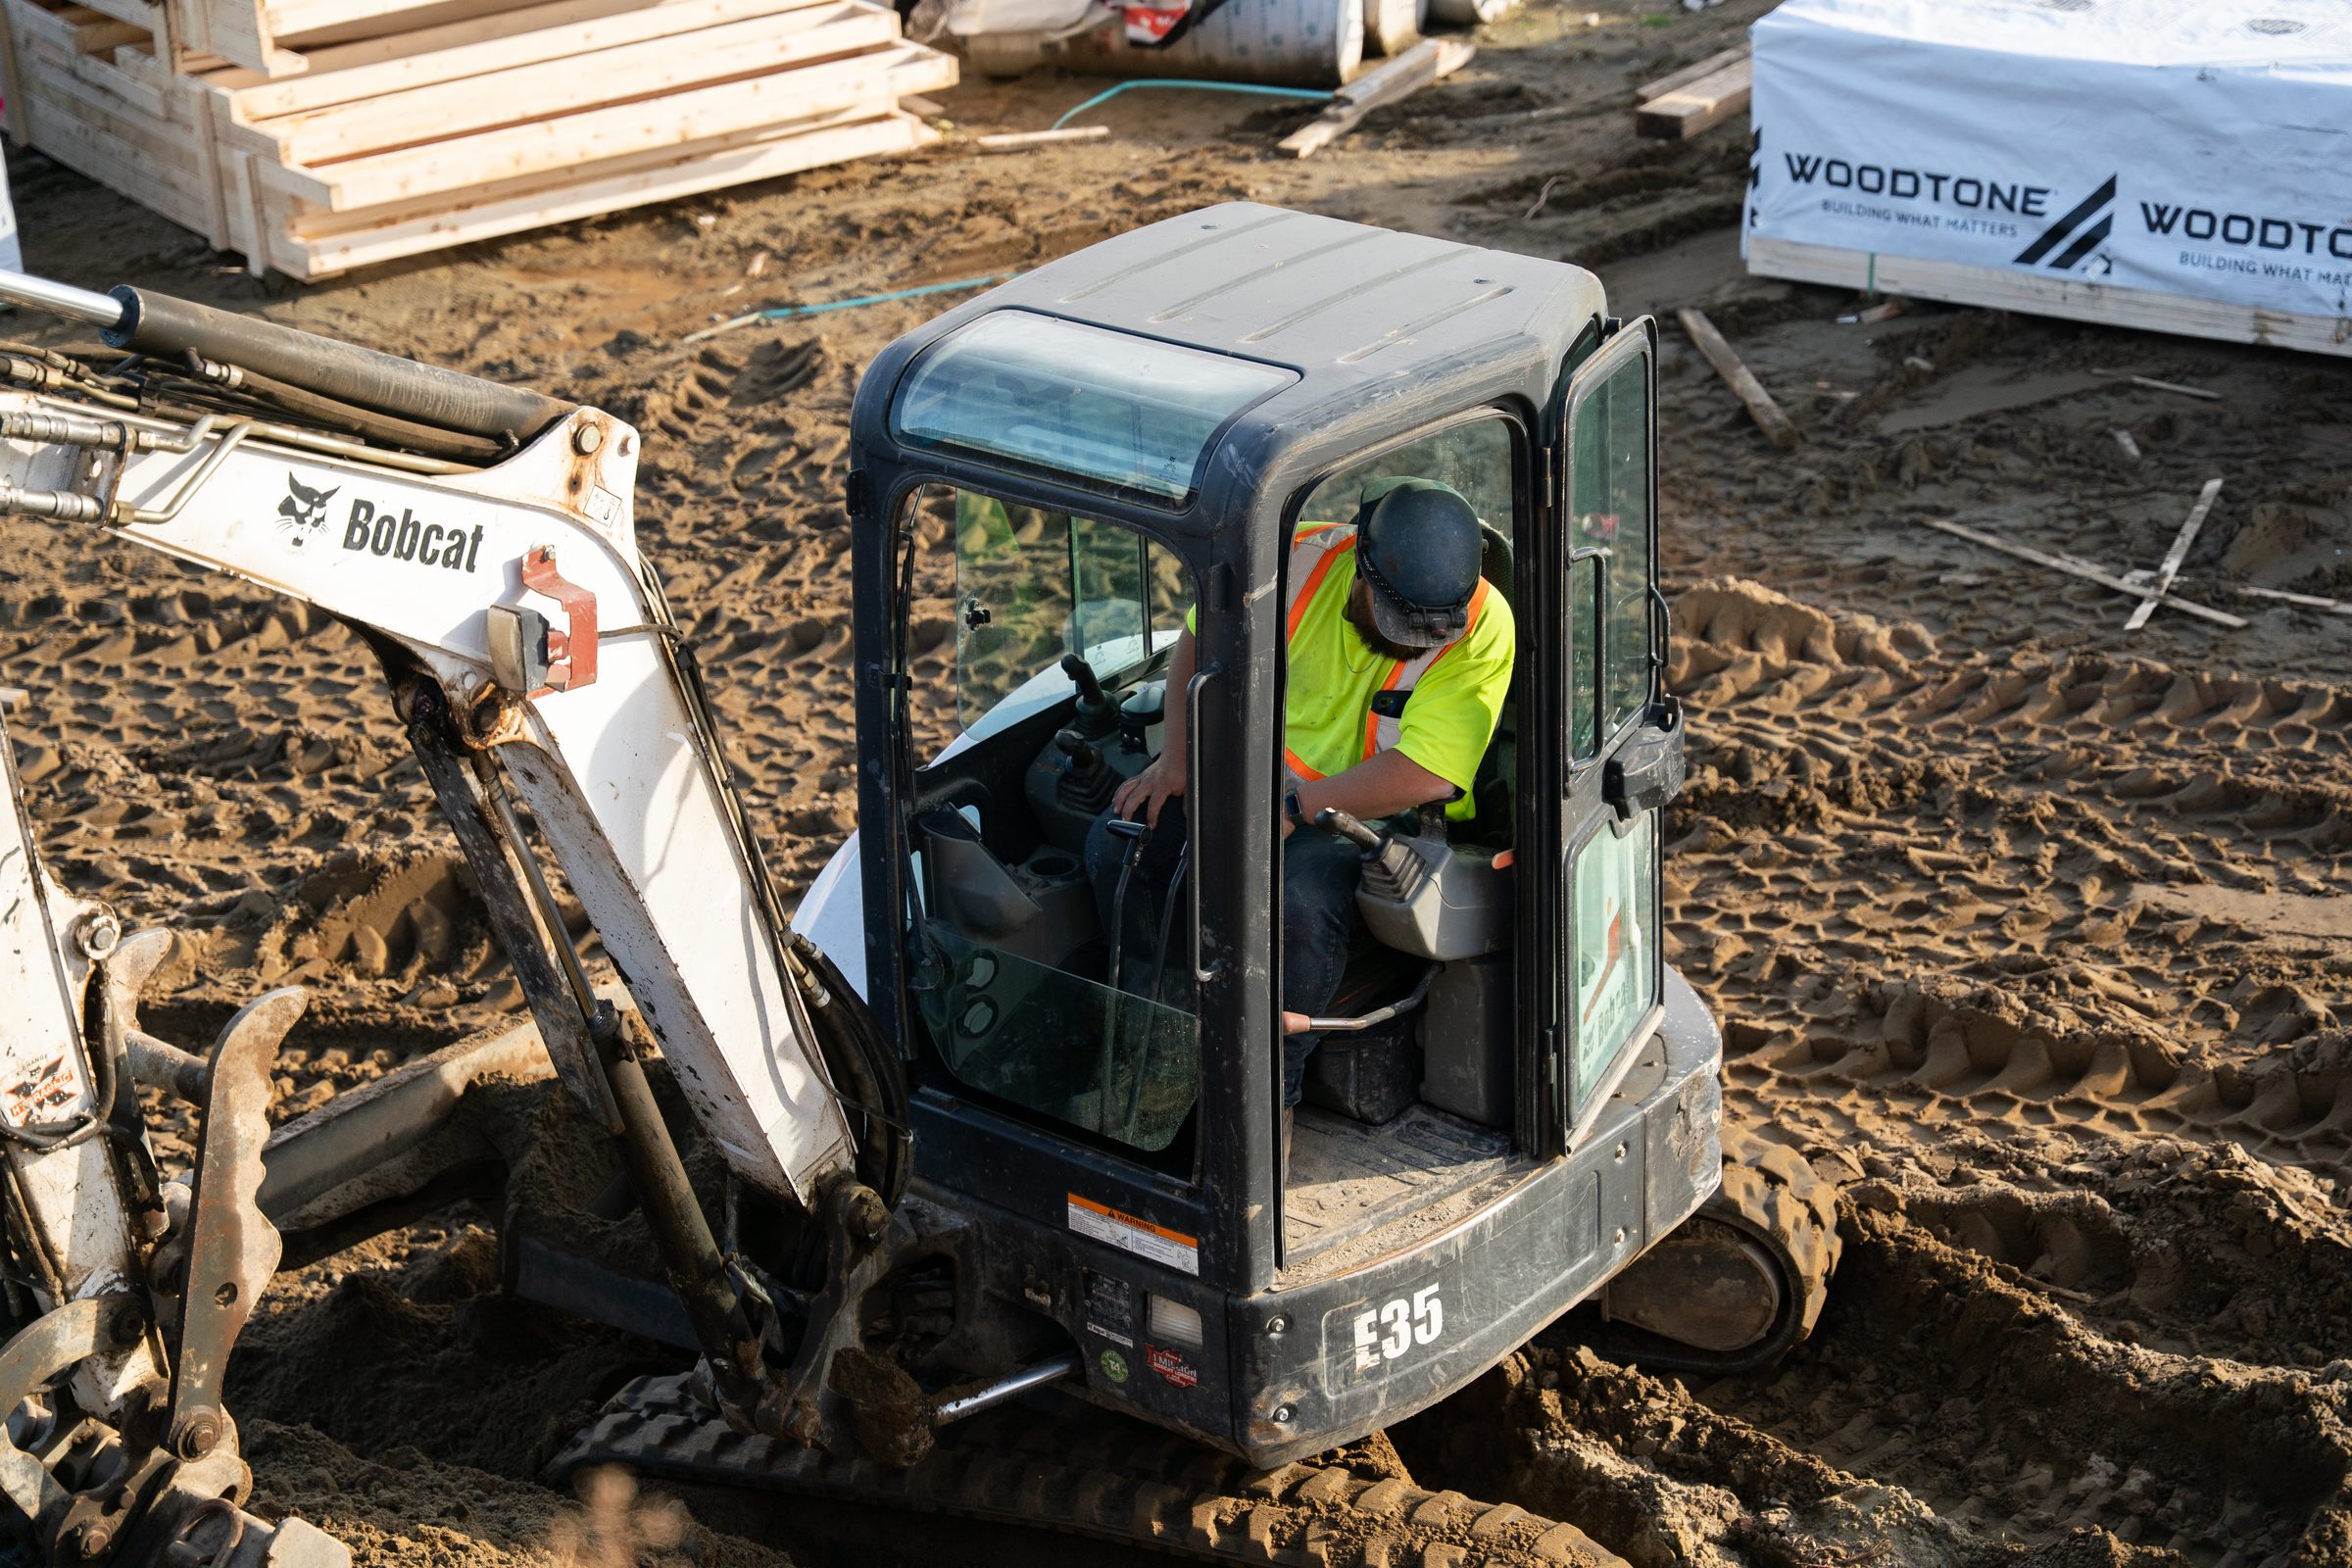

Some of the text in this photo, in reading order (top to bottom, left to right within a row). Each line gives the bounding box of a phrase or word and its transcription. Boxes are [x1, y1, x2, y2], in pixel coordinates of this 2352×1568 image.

[1784, 152, 2050, 218] WOODTONE
[1821, 198, 2019, 238] BUILDING WHAT MATTERS
[2179, 251, 2257, 274] BUILDING
[2263, 261, 2314, 281] WHAT
[343, 498, 484, 573] Bobcat
[1117, 1211, 1156, 1233] WARNING
[1354, 1282, 1444, 1371] E35
